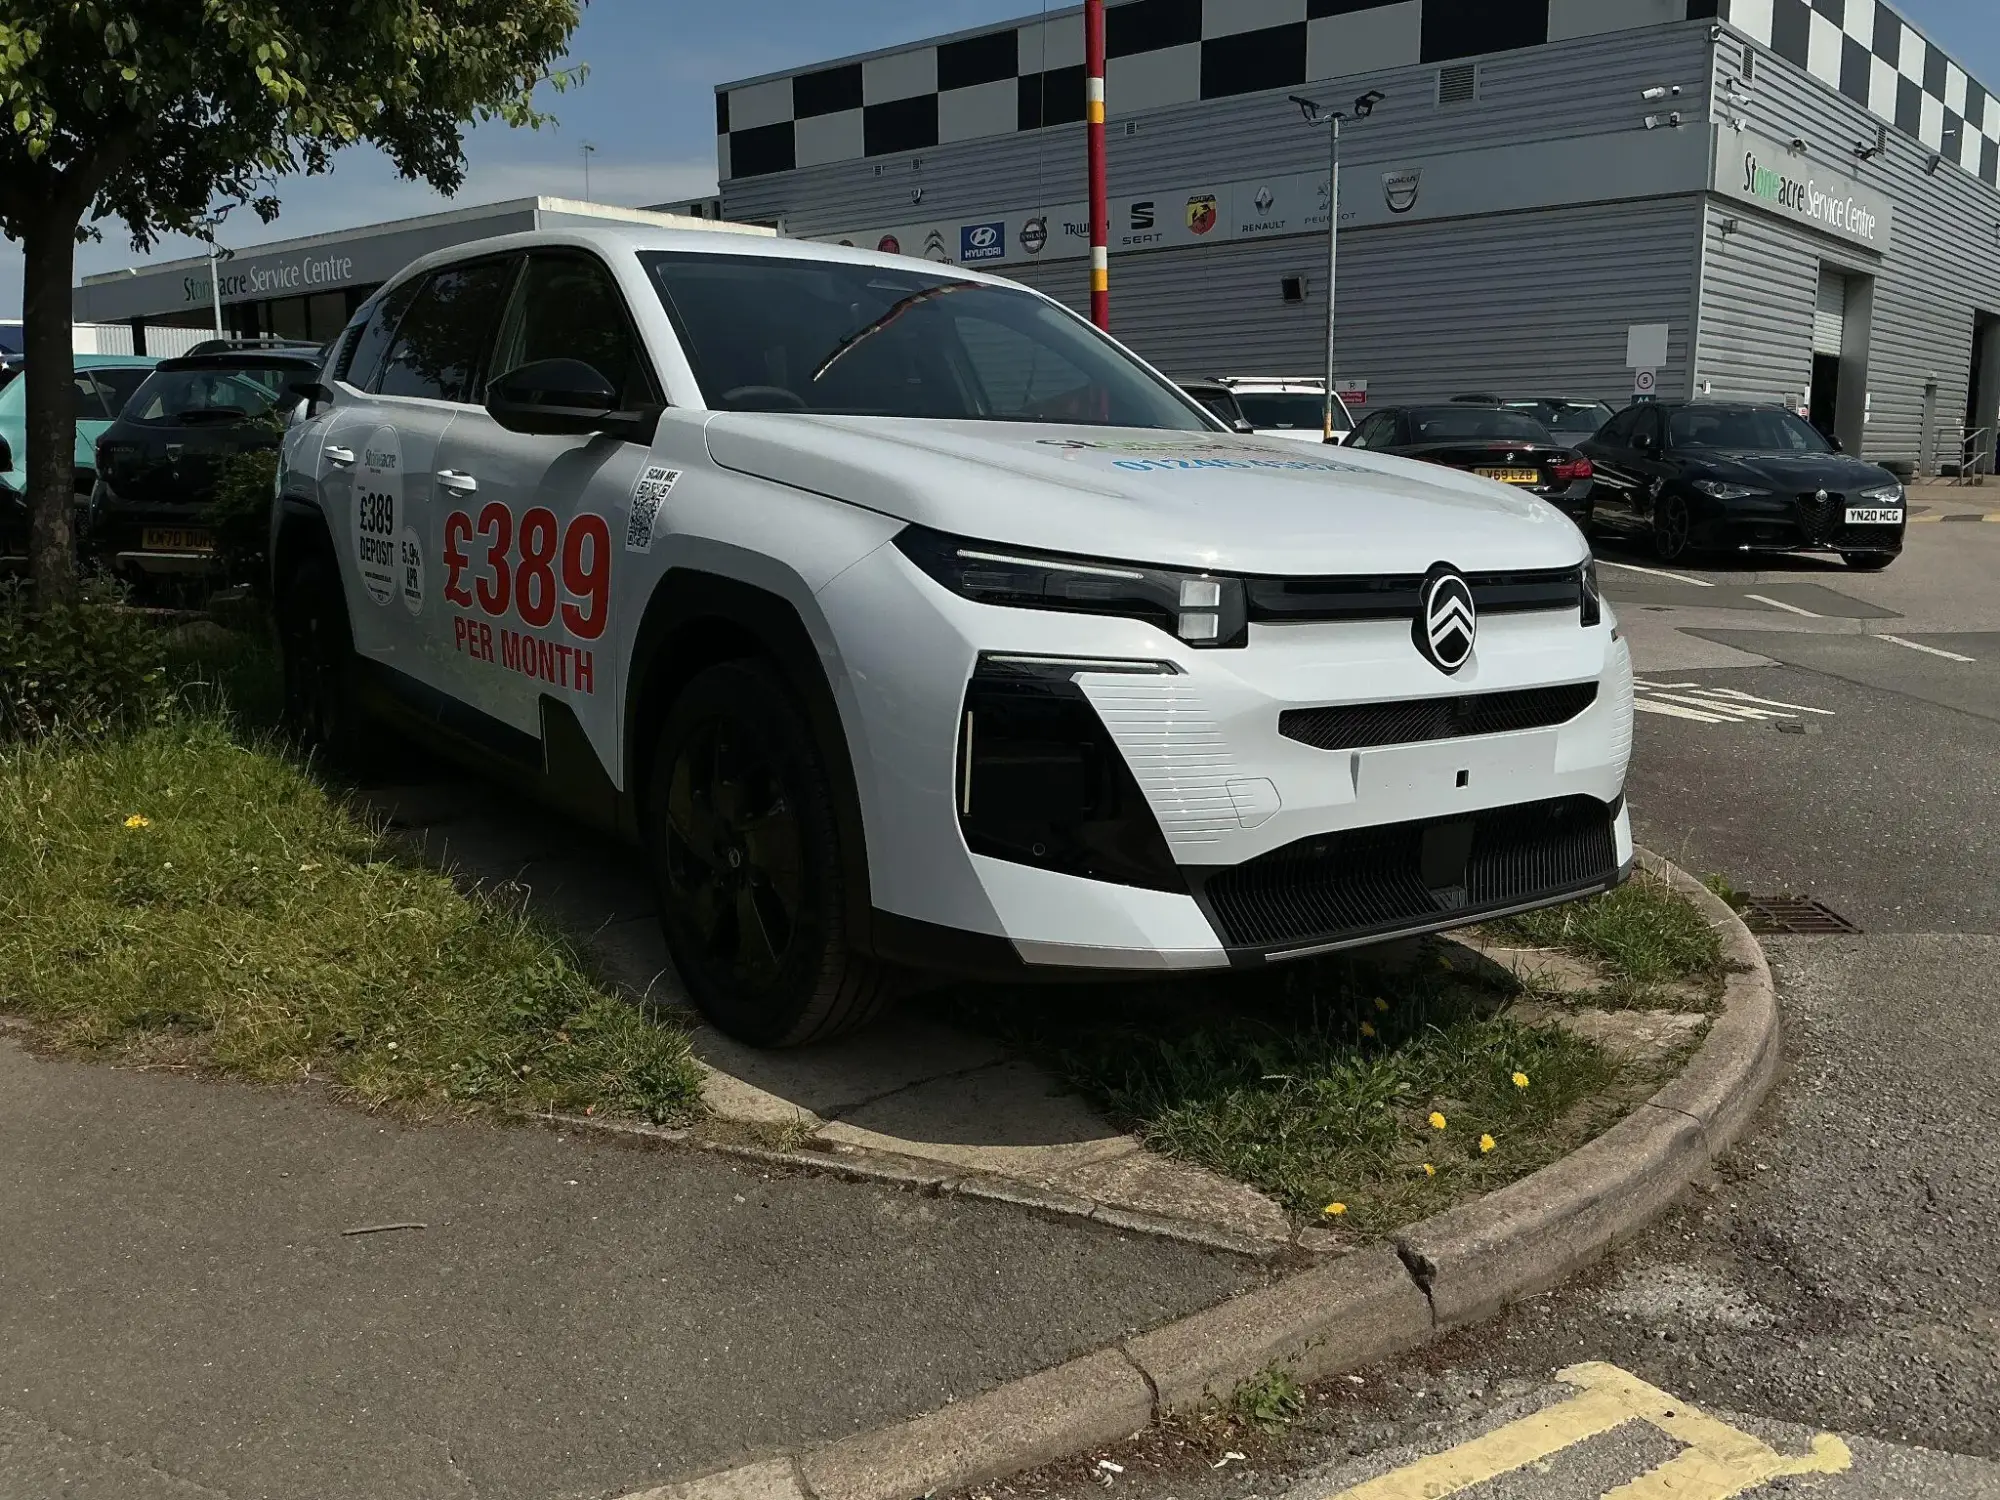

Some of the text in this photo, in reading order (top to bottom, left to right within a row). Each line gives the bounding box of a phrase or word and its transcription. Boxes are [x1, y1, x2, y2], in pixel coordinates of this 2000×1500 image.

[1743, 151, 1876, 240] Stoneacre Service Centre
[1304, 212, 1356, 224] PEUGOT
[1063, 220, 1110, 238] TRIUH
[1242, 220, 1286, 233] RENAULT
[1122, 233, 1163, 245] SEAT
[964, 247, 1001, 259] HYUNDAI
[184, 254, 353, 301] Stonacre Service Centre
[1642, 376, 1650, 385] 5
[646, 468, 678, 482] SCAN ME
[1511, 469, 1533, 480] LZB
[359, 492, 393, 536] £389
[1850, 510, 1898, 521] YN20 HCG
[359, 536, 394, 568] DEPOSIT
[402, 541, 421, 567] 5.9%
[442, 500, 613, 641] £389
[453, 615, 595, 694] PER MONTH
